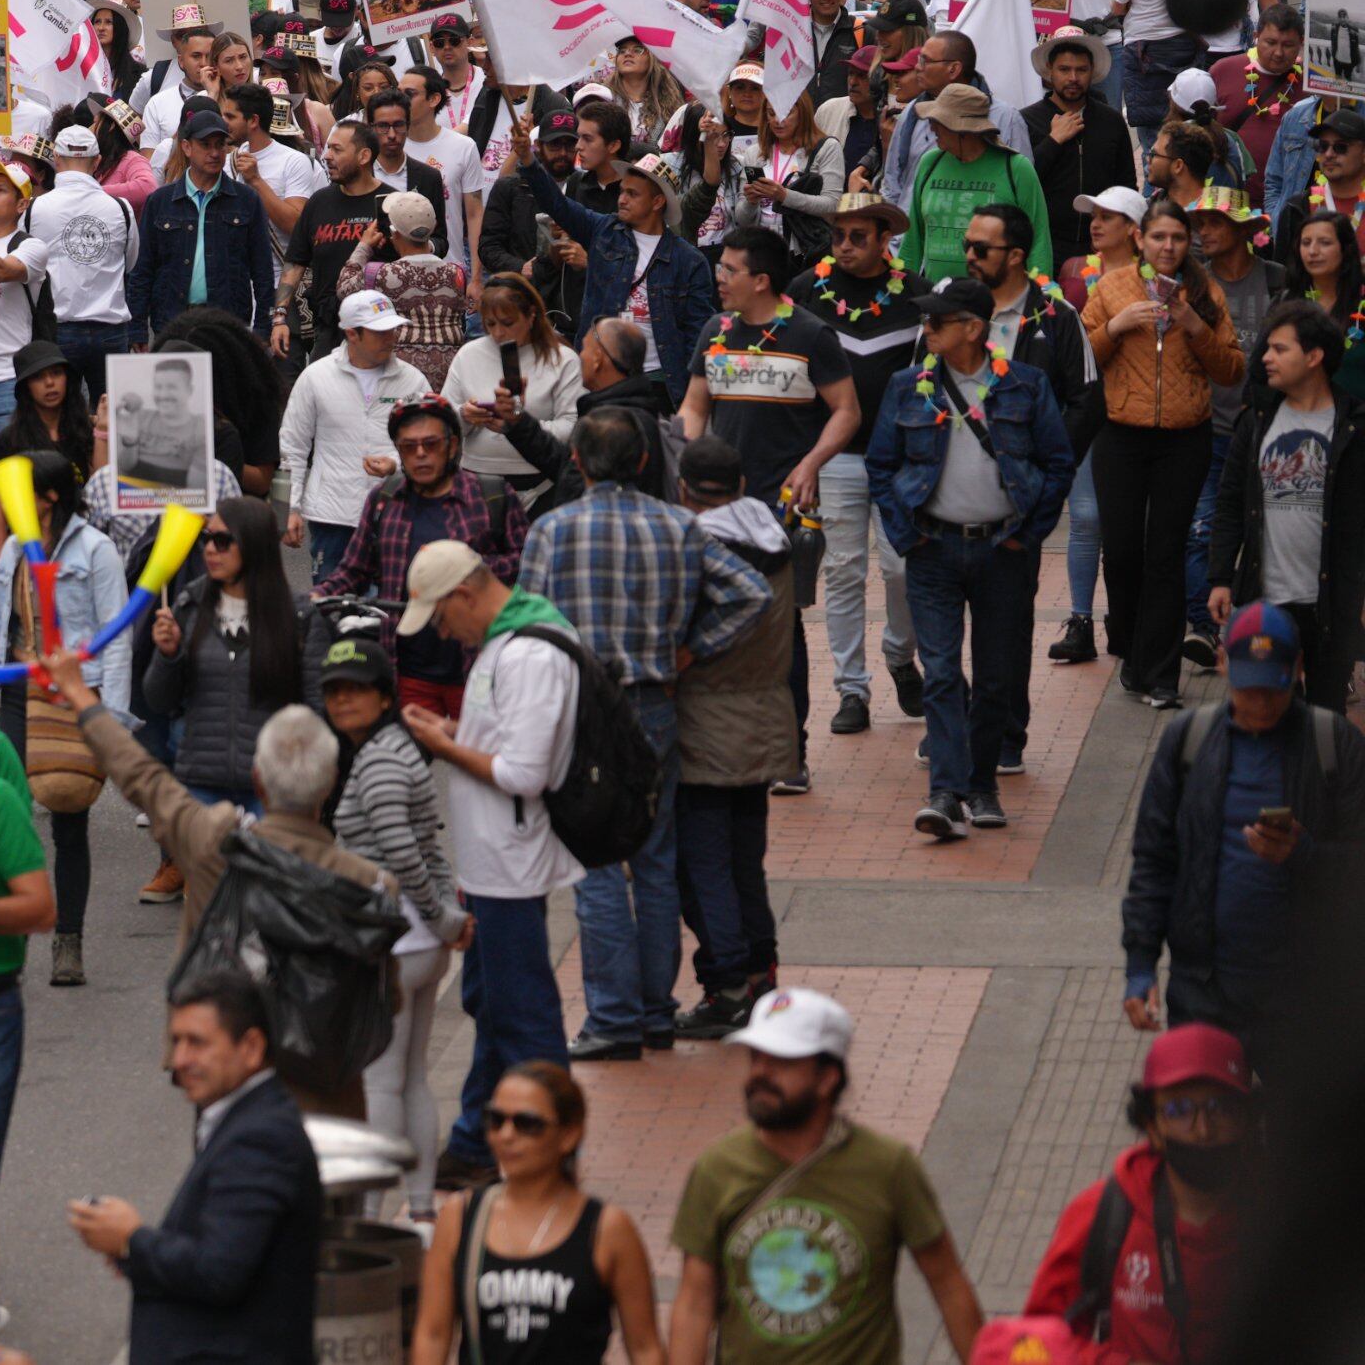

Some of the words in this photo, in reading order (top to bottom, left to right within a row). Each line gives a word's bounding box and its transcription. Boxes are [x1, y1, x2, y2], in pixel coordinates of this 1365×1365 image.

[42, 9, 69, 34] Cambio
[558, 29, 591, 59] SOCIEDAD
[590, 22, 603, 34] DE
[931, 179, 965, 189] NEVER
[971, 181, 996, 190] STOP
[705, 364, 795, 392] Superdry
[119, 496, 206, 508] #PROTEJAMOSLAVIDA
